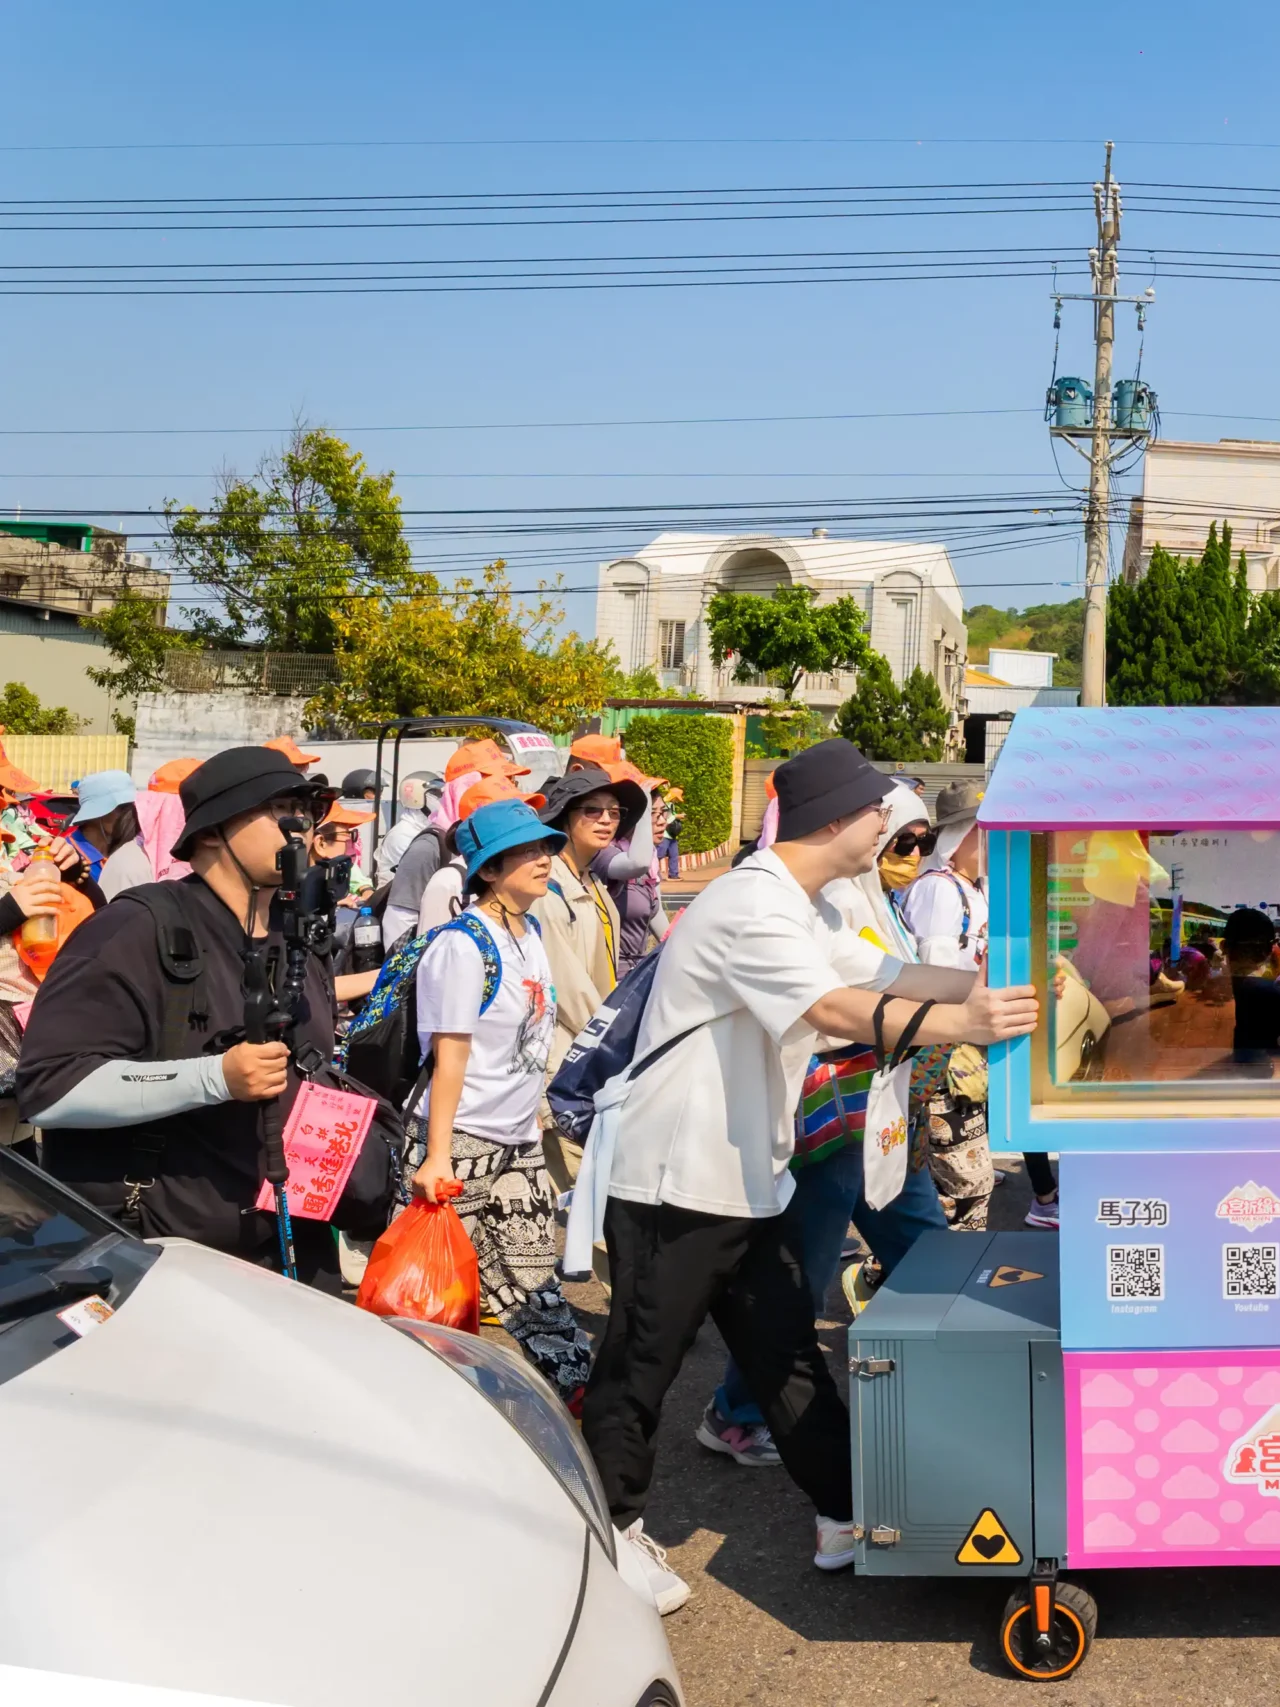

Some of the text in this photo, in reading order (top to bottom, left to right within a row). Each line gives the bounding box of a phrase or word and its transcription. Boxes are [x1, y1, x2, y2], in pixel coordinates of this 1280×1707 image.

[1098, 1200, 1168, 1226] 馬子狗
[1231, 1215, 1271, 1223] MIYA KIEN
[1111, 1303, 1158, 1315] Instagram
[1234, 1302, 1270, 1312] Youtube
